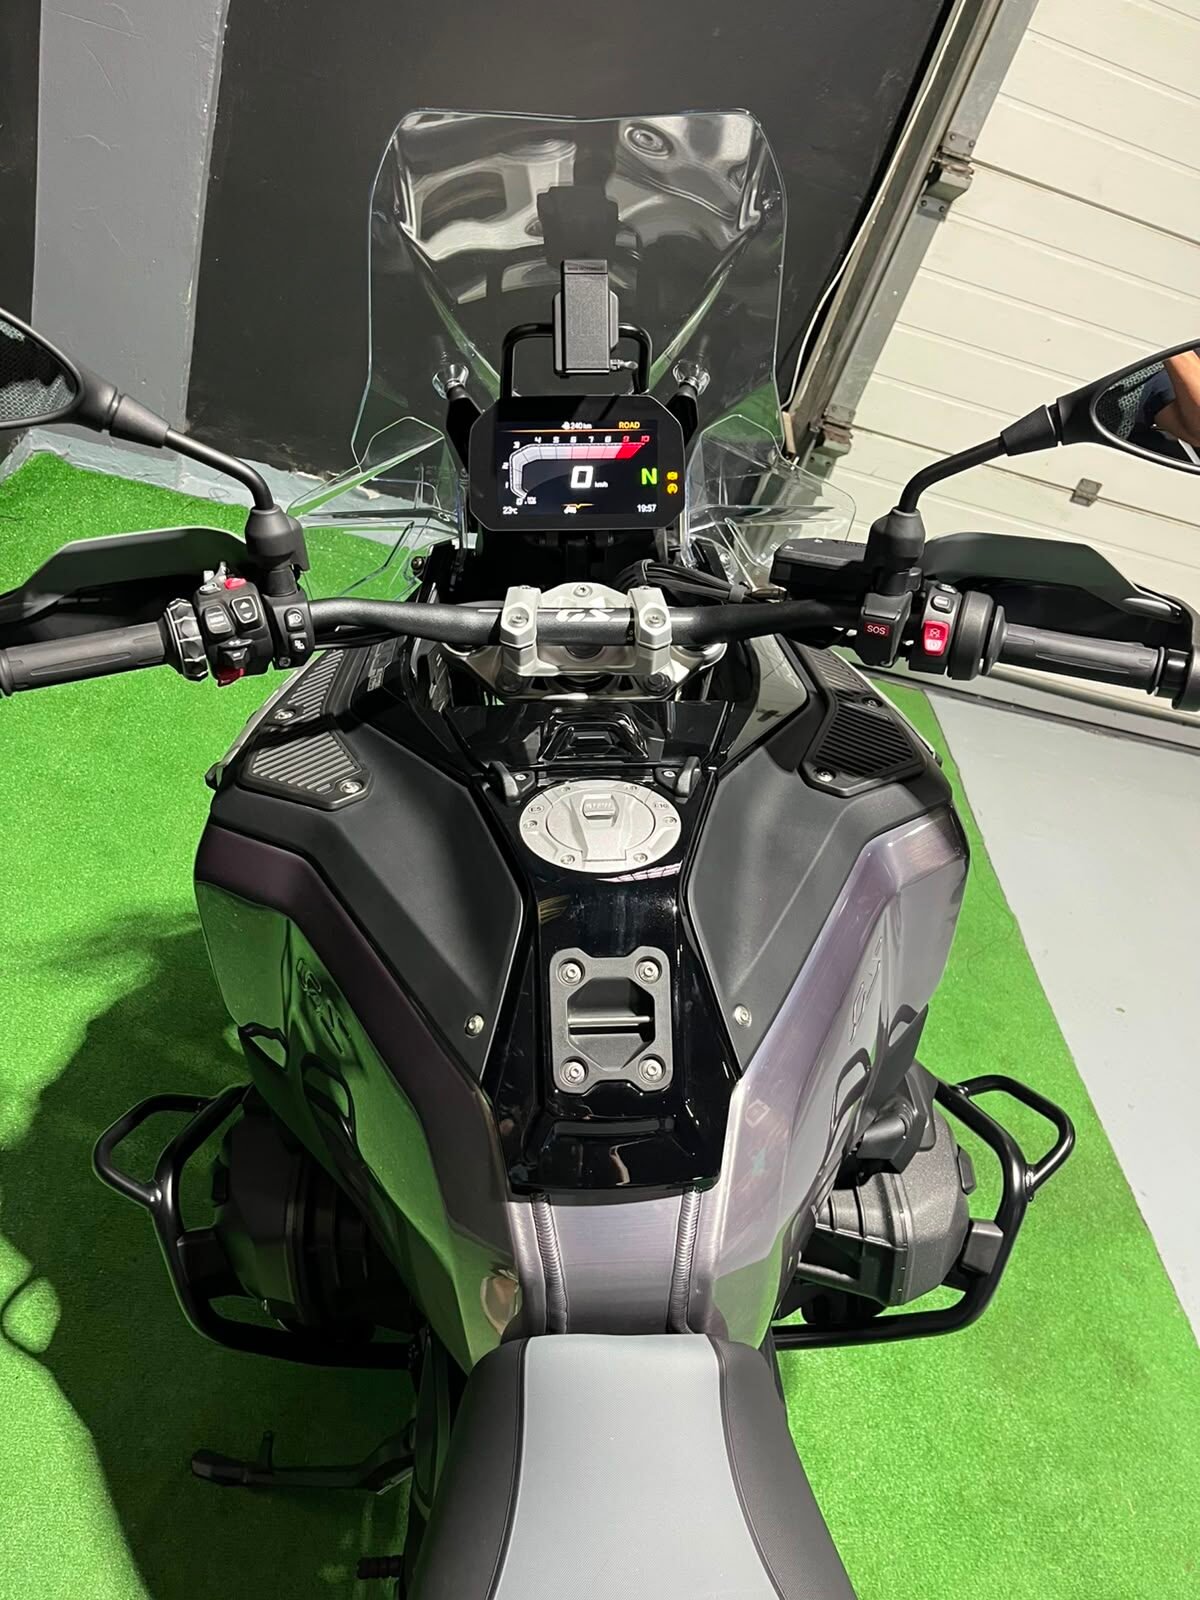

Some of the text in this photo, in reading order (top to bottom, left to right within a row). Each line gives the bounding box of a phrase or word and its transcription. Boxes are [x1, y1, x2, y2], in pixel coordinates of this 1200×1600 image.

[618, 421, 640, 429] ROAD
[588, 435, 595, 443] 7
[640, 435, 650, 443] 10
[501, 462, 509, 470] 2
[570, 465, 594, 489] 0
[641, 467, 657, 485] N
[636, 503, 657, 513] 19:57
[555, 608, 616, 623] GS
[866, 624, 886, 635] SOS
